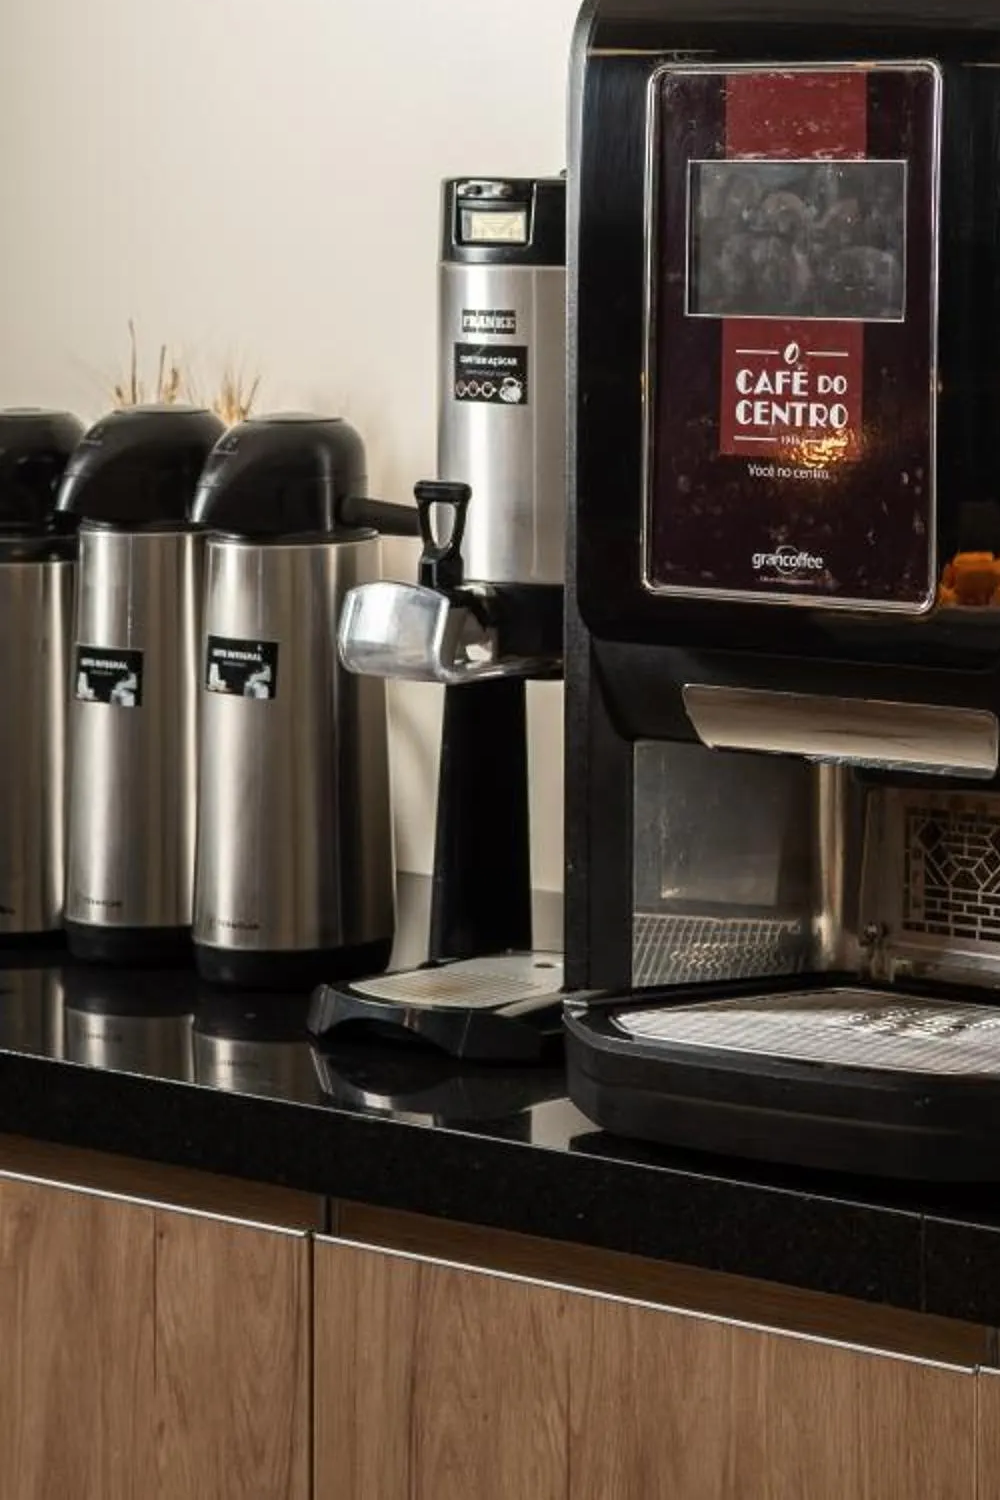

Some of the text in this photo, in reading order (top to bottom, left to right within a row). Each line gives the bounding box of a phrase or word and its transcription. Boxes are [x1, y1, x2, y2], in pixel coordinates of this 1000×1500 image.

[735, 364, 848, 397] CAFÉ DO
[735, 399, 849, 429] CENTRO
[747, 463, 775, 479] Você
[777, 466, 791, 479] no
[752, 551, 824, 569] grancoffee
